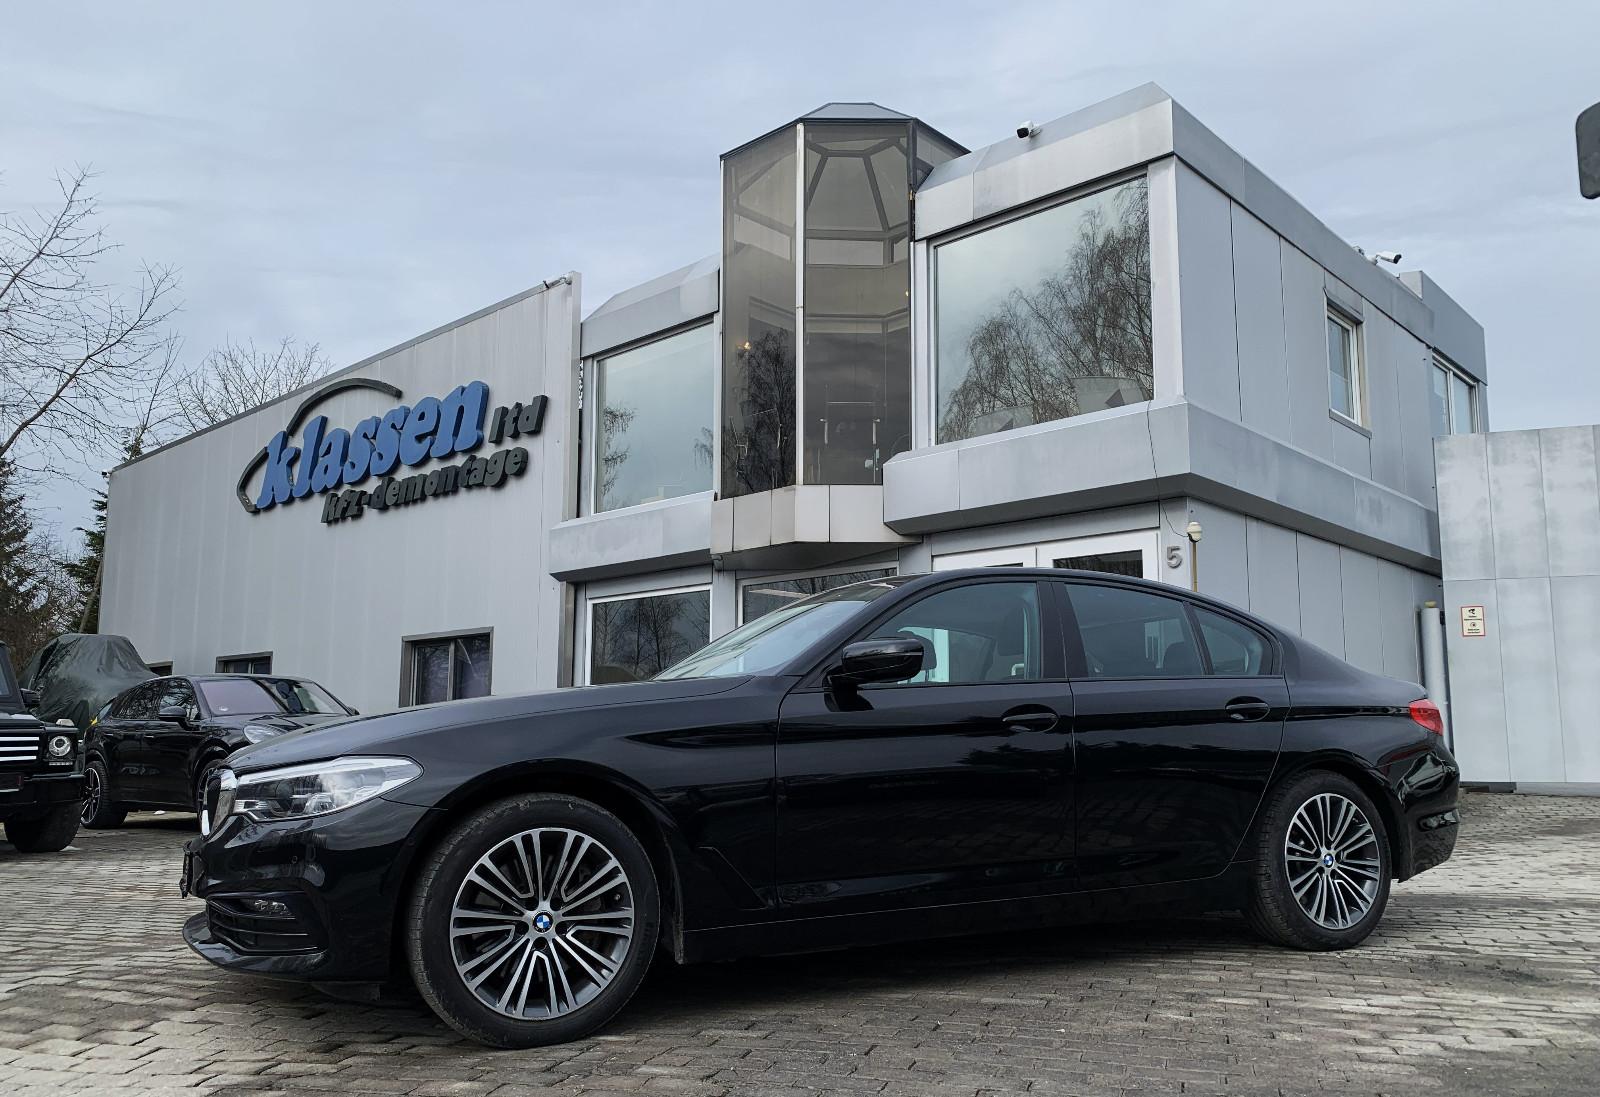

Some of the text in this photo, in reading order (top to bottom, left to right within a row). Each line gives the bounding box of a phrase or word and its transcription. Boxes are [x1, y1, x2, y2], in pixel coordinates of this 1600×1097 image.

[256, 380, 548, 509] klassen ltd
[321, 447, 529, 523] kfz-demontage
[1167, 545, 1183, 569] 5
